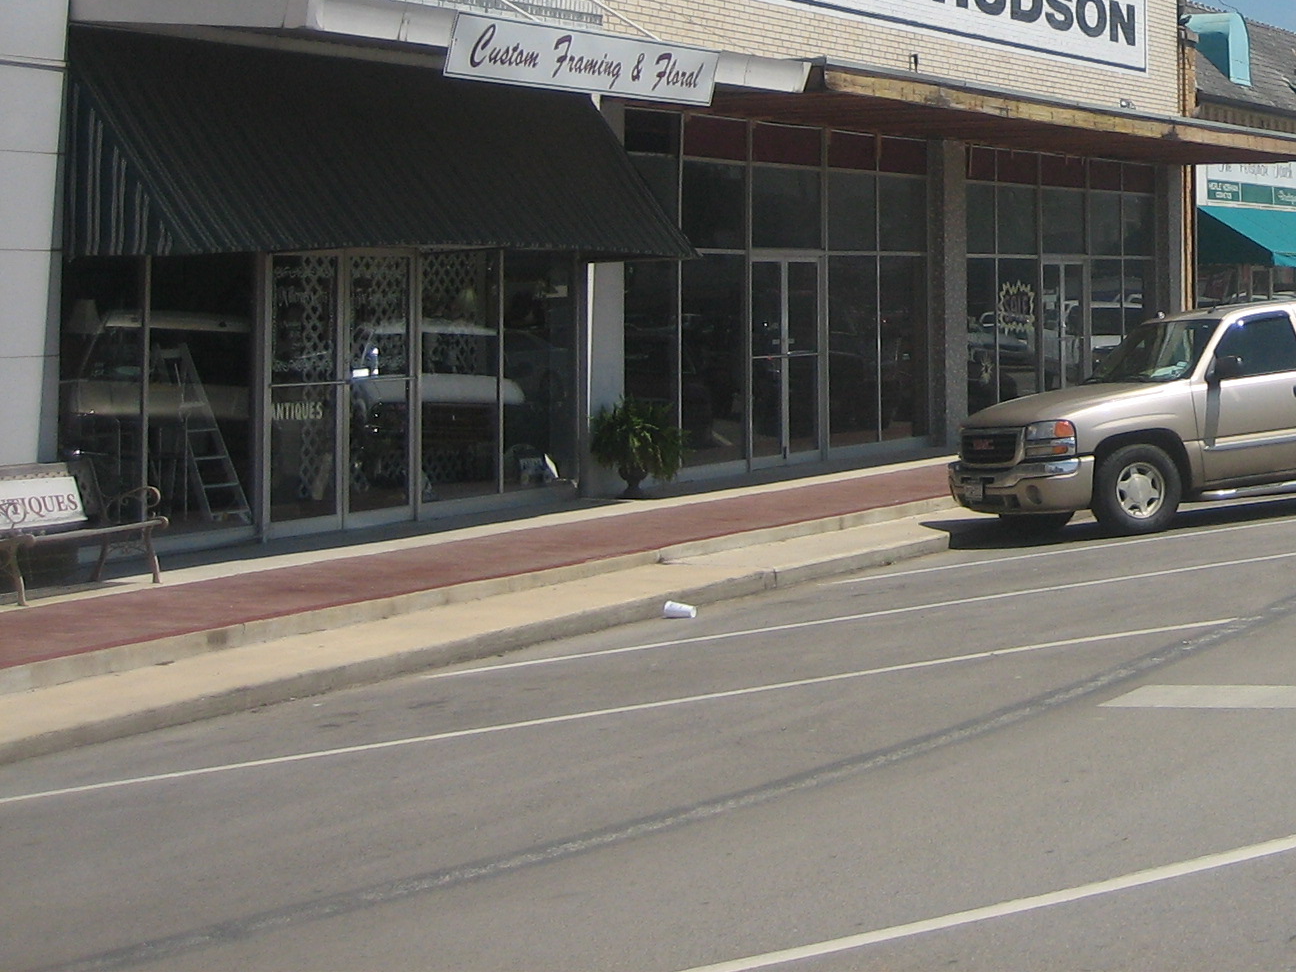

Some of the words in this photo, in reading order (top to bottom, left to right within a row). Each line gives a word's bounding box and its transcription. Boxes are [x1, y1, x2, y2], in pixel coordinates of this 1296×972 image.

[470, 24, 540, 68] Custom
[552, 35, 622, 90] Framing
[632, 53, 646, 82] &
[652, 52, 704, 91] Floral
